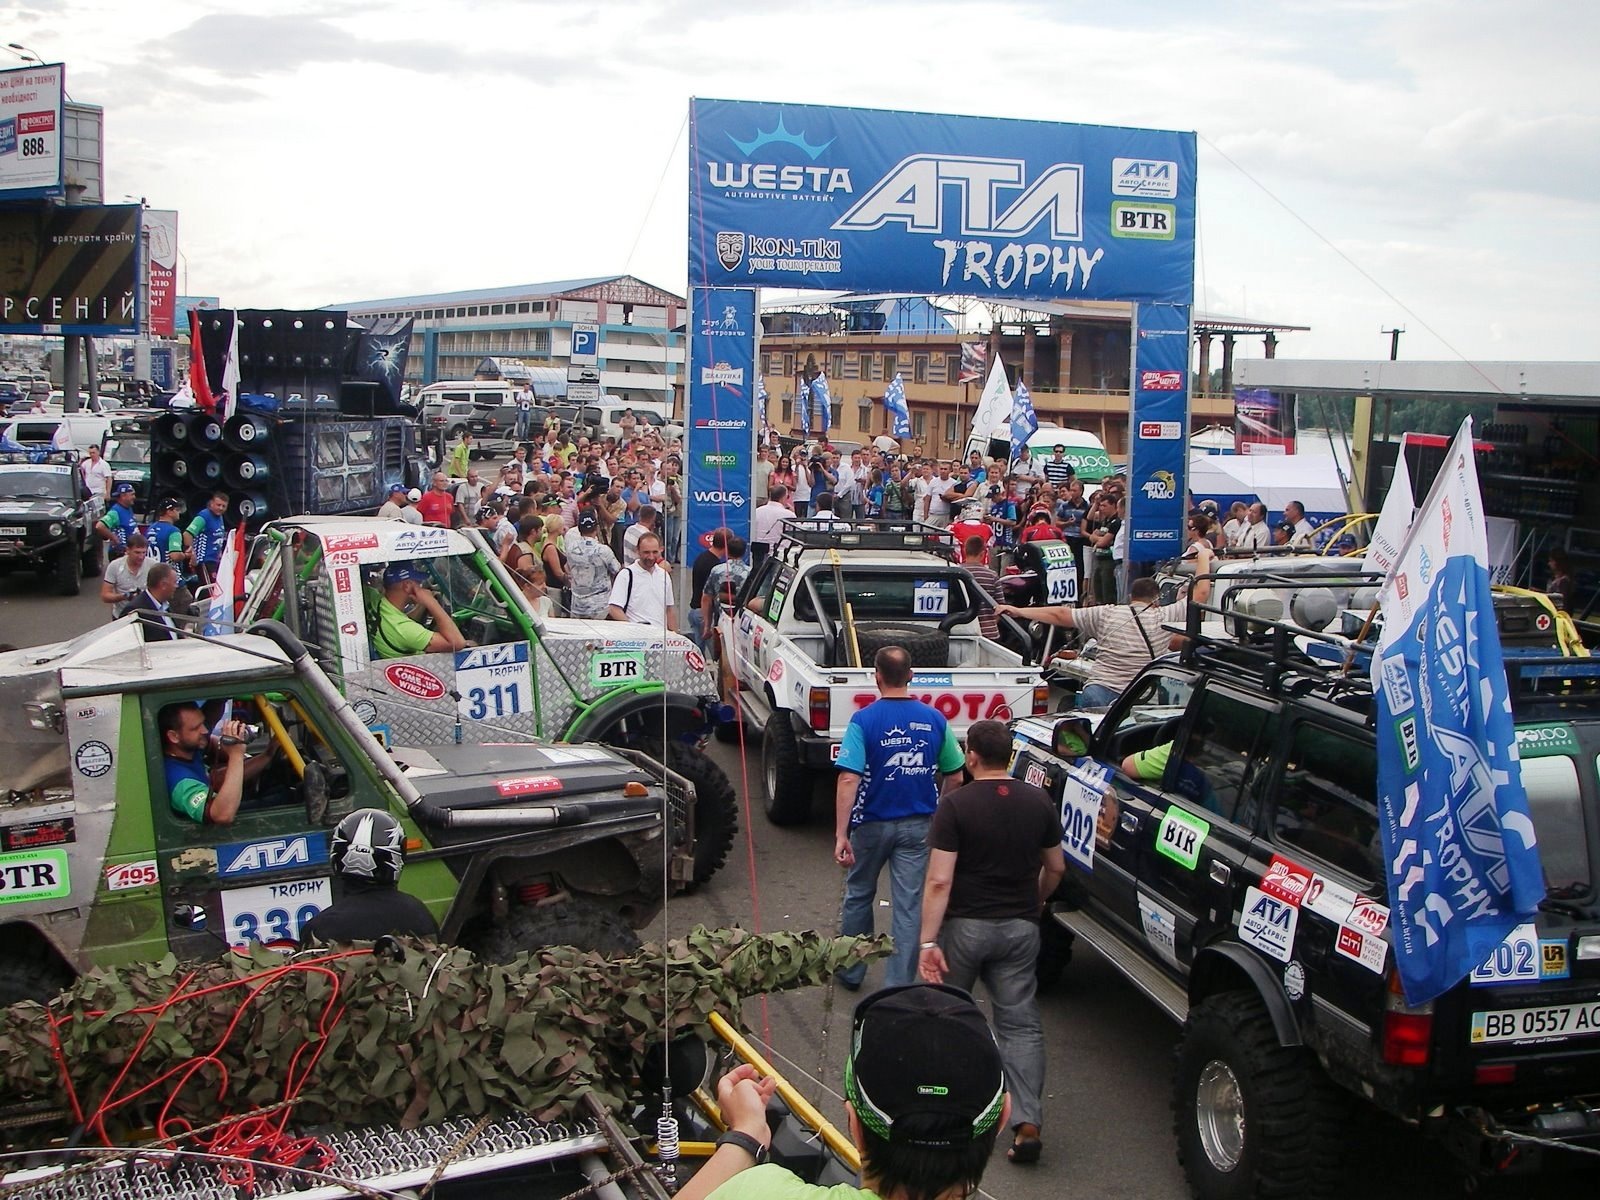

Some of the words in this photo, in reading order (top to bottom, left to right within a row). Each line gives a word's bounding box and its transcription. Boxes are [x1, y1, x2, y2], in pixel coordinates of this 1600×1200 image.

[23, 137, 44, 156] 888
[707, 162, 853, 193] WESTA
[725, 191, 787, 200] AUTOMOTIVE
[792, 194, 834, 202] BATTERY
[1119, 210, 1167, 230] BTR
[748, 234, 842, 259] KON-TIKI
[933, 240, 1105, 292] TROPHY
[1141, 481, 1167, 491] АВТО
[1147, 489, 1175, 500] РАДІО
[694, 491, 740, 502] WOLF
[1135, 531, 1174, 539] БОРИС
[1047, 548, 1069, 559] BTR
[1051, 577, 1076, 599] 450
[918, 596, 943, 611] 107
[488, 664, 525, 678] TROPHY
[599, 661, 637, 678] BTR
[912, 676, 951, 684] БОРИС
[469, 682, 520, 720] 311
[880, 737, 912, 747] WESTA
[1402, 723, 1417, 768] BTR
[901, 766, 930, 776] TROPHY
[1027, 766, 1045, 788] ORM
[1062, 801, 1093, 857] 202
[1163, 819, 1197, 855] BTR
[1425, 793, 1499, 921] TROPHY
[1270, 860, 1289, 876] АВТО
[269, 880, 324, 900] TROPHY
[1261, 881, 1300, 904] ЖУРНАЛ
[1144, 920, 1173, 946] WESTA
[1485, 1015, 1515, 1037] BB
[1521, 1008, 1570, 1034] 0557
